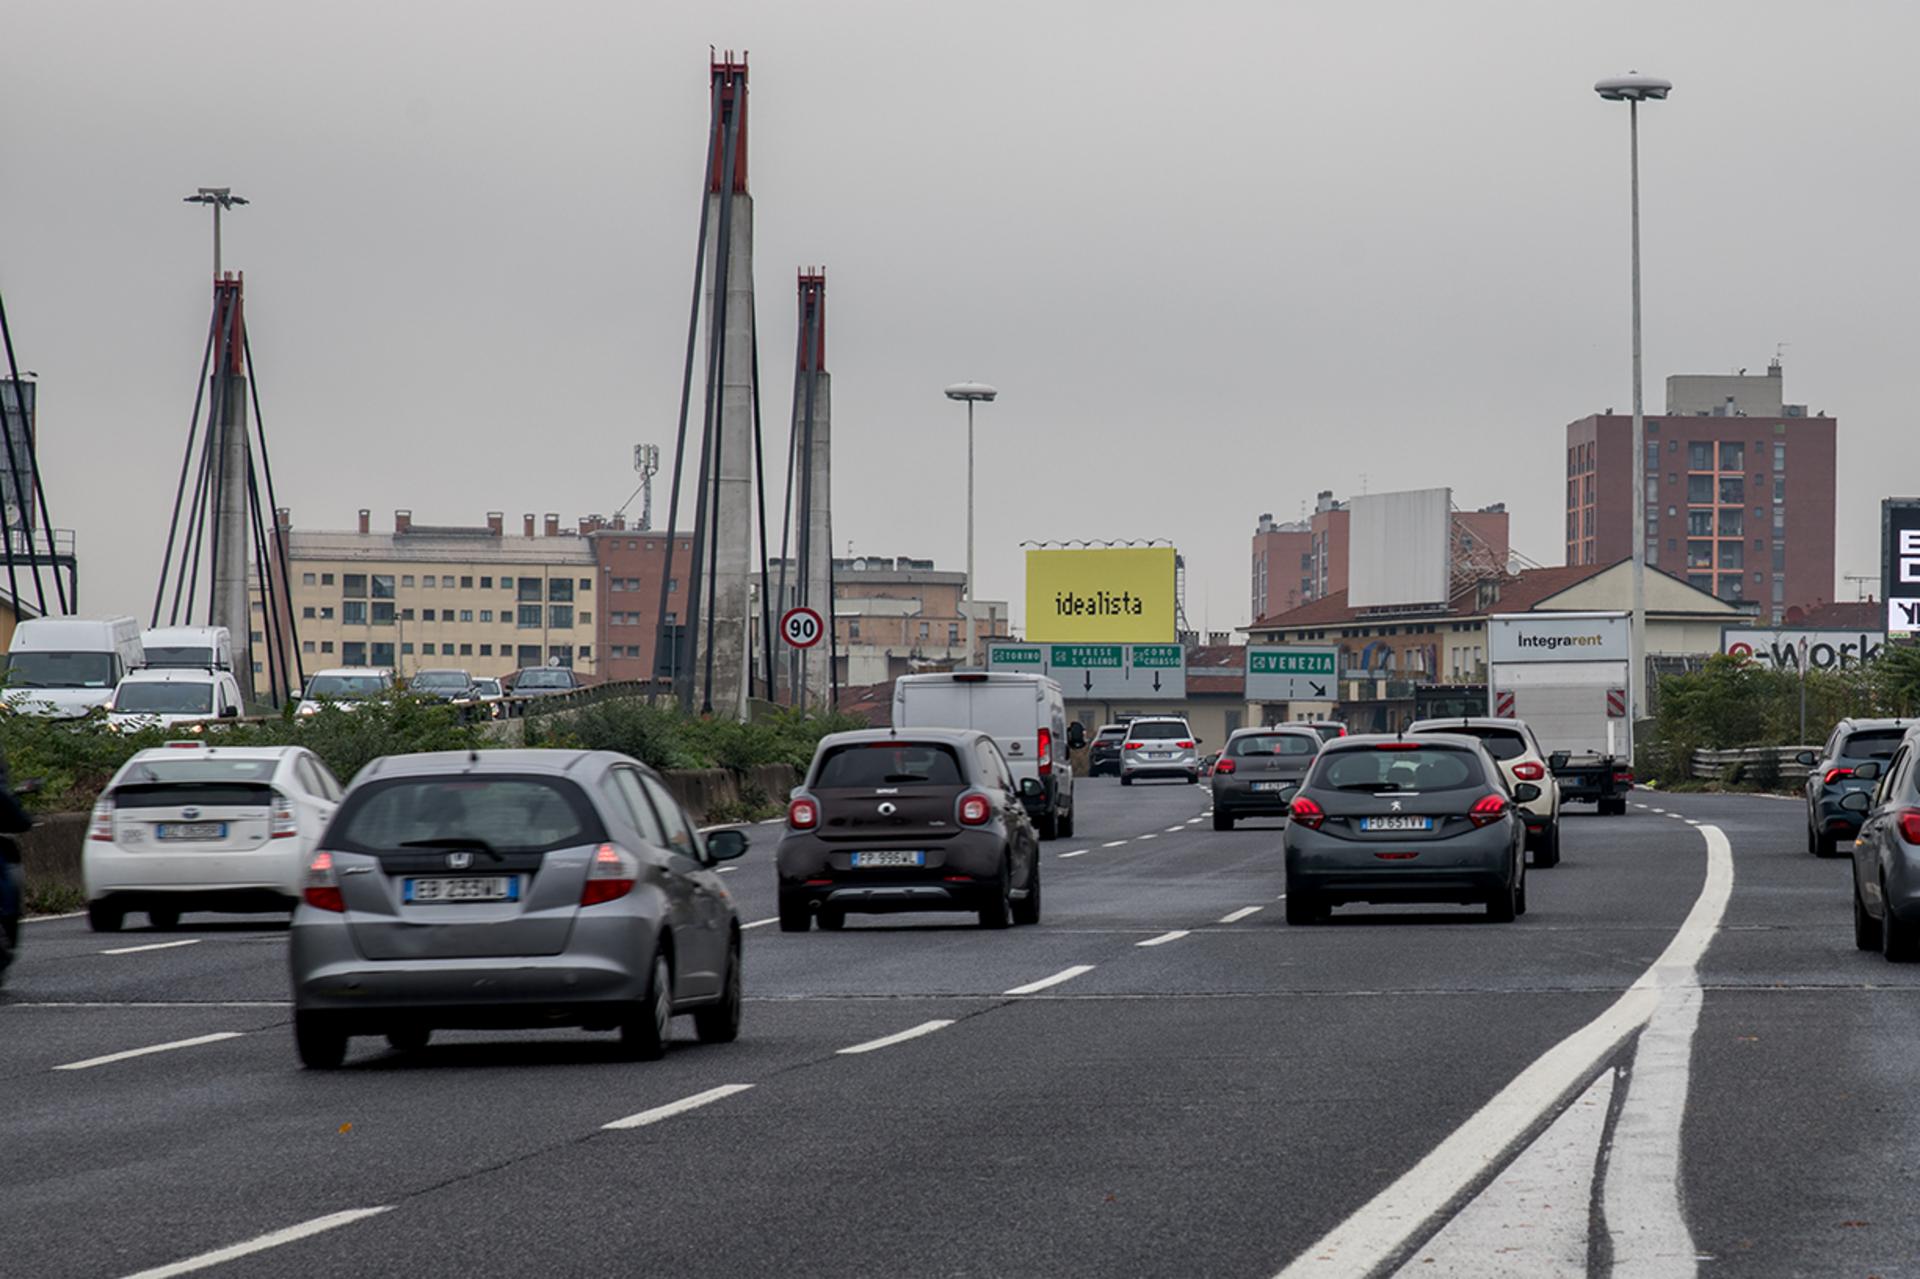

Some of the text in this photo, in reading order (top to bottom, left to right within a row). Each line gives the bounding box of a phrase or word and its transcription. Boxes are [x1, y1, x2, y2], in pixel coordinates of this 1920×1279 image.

[1055, 591, 1142, 615] idealista
[791, 618, 814, 638] 90
[1006, 651, 1040, 660] TORINO
[1071, 648, 1111, 656] VARESE
[1143, 648, 1173, 656] COMO
[1143, 657, 1180, 665] CHIASSO
[1268, 656, 1332, 671] VENEZIA
